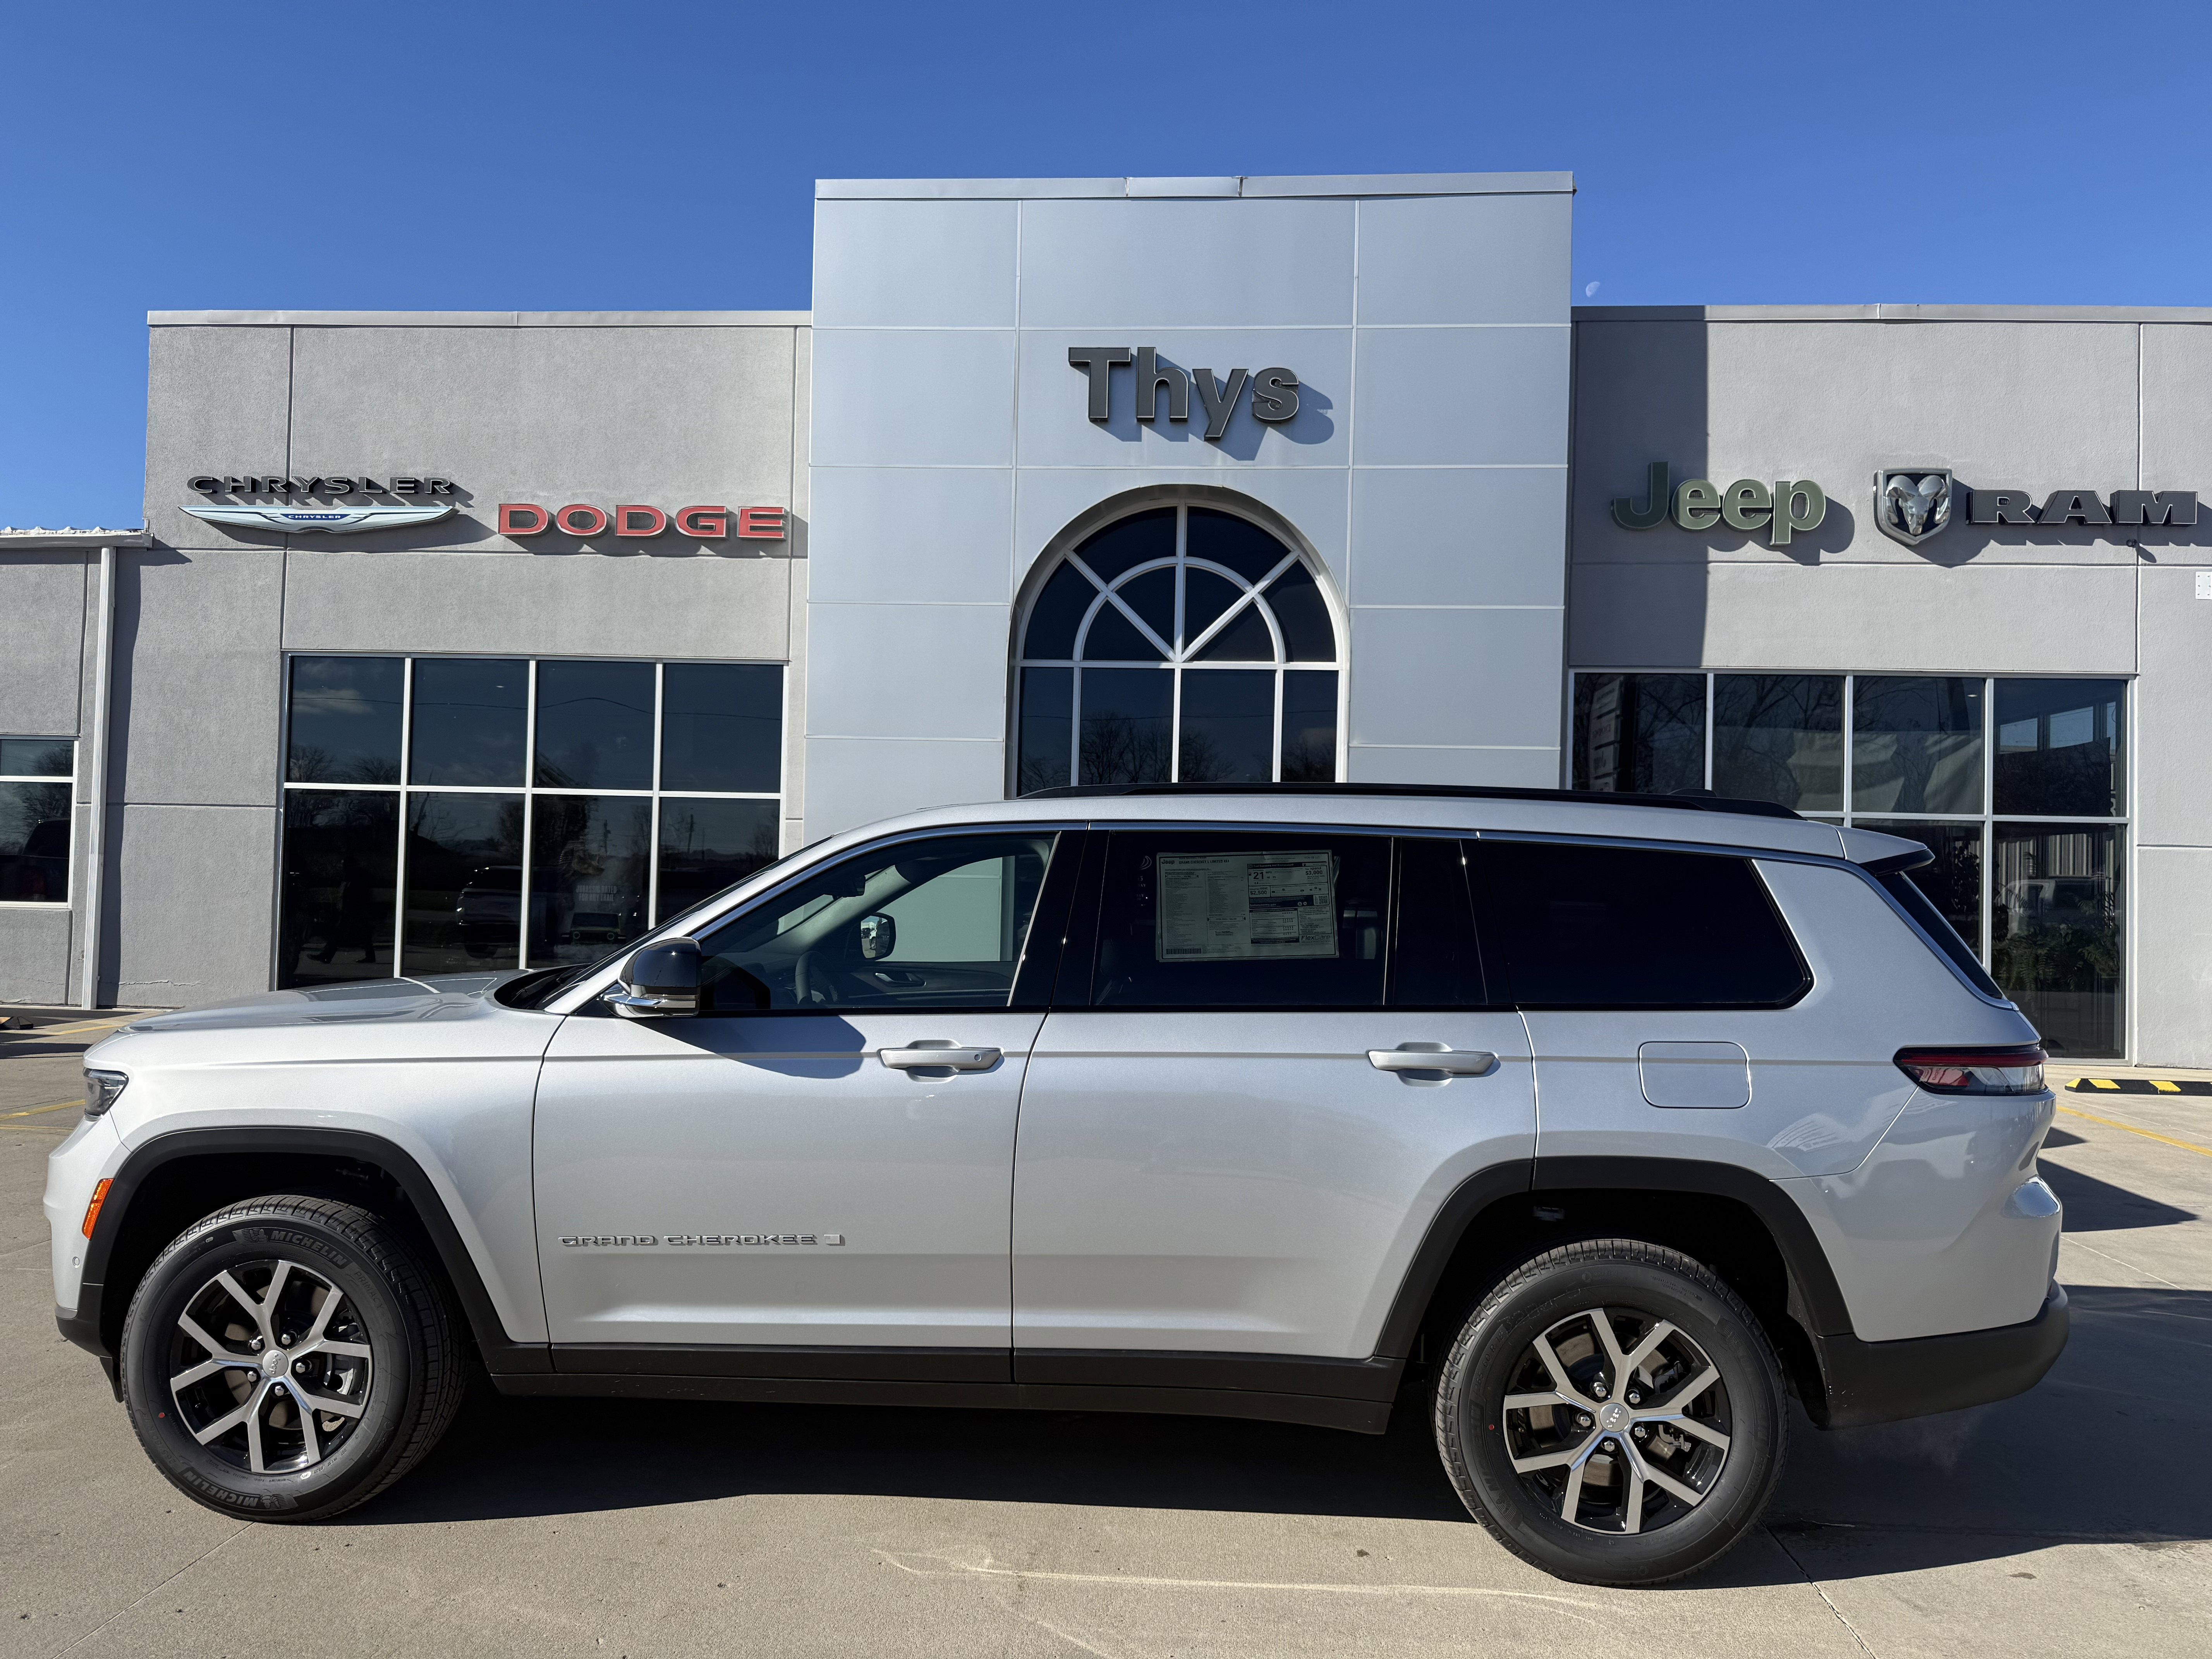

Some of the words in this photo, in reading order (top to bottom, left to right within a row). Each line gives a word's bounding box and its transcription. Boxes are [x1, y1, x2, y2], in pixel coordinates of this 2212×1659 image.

[1068, 347, 1299, 441] Thys
[187, 476, 455, 495] CHRYSLER
[1611, 461, 1826, 546] Jeep
[498, 503, 786, 539] DODGE
[1966, 489, 2198, 525] RAM
[1253, 871, 1264, 879] 21
[579, 893, 589, 901] FOR
[601, 893, 614, 902] TRAIL
[271, 1230, 348, 1267] MICHELIN
[558, 1235, 655, 1245] GRAND
[663, 1234, 816, 1245] CHEROKEE
[354, 1271, 385, 1310] PRIMACY
[183, 1469, 259, 1508] MICHELIN
